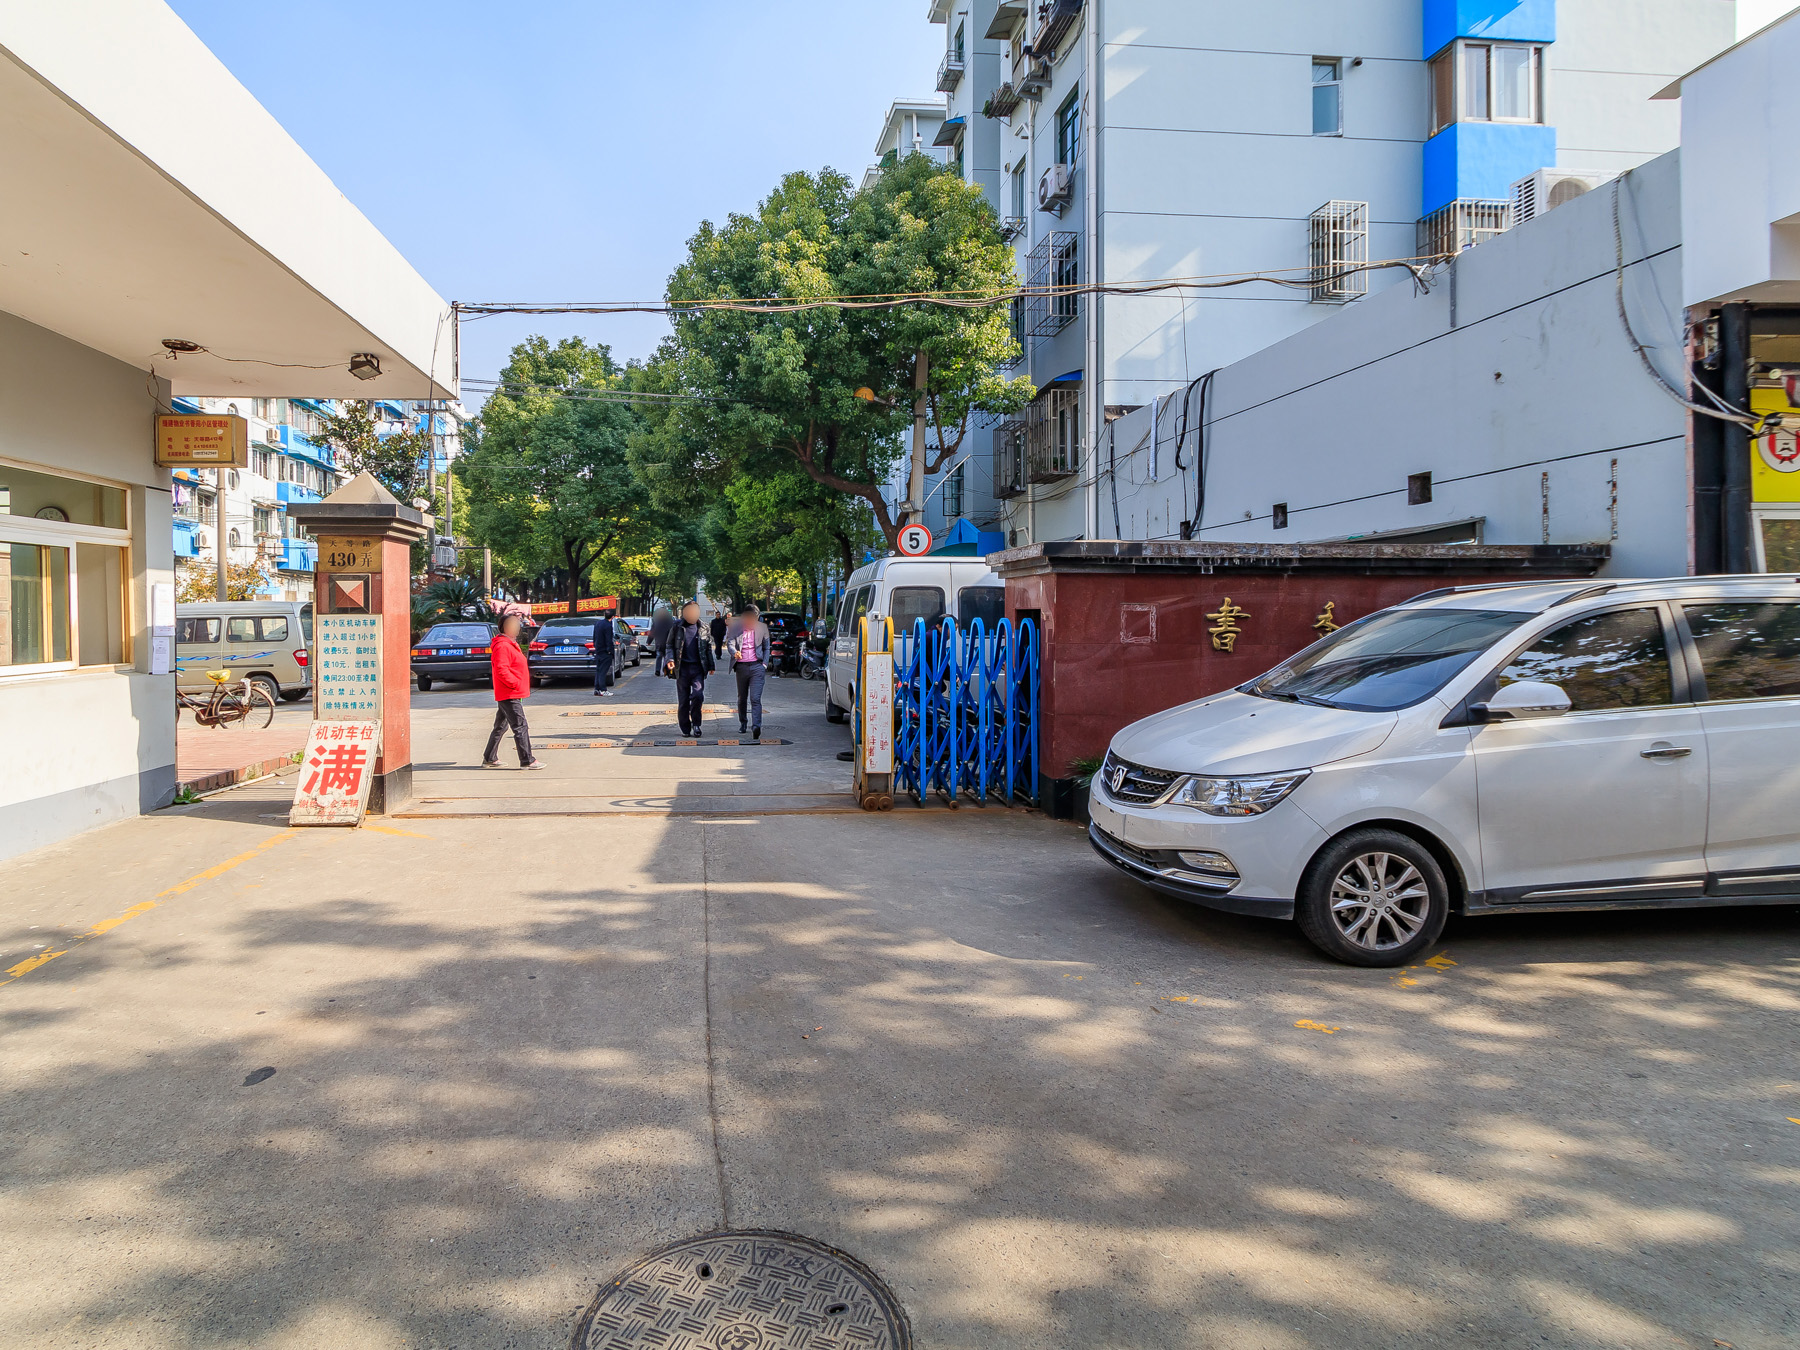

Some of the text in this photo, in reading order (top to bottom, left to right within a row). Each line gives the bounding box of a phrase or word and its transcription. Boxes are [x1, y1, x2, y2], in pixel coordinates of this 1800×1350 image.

[329, 539, 371, 548] 天等路
[909, 532, 920, 550] 5
[323, 619, 377, 628] 本小区机动车辆
[323, 633, 377, 642] 进入超过1小时
[315, 724, 374, 741] 机动车位
[302, 744, 366, 797] 满
